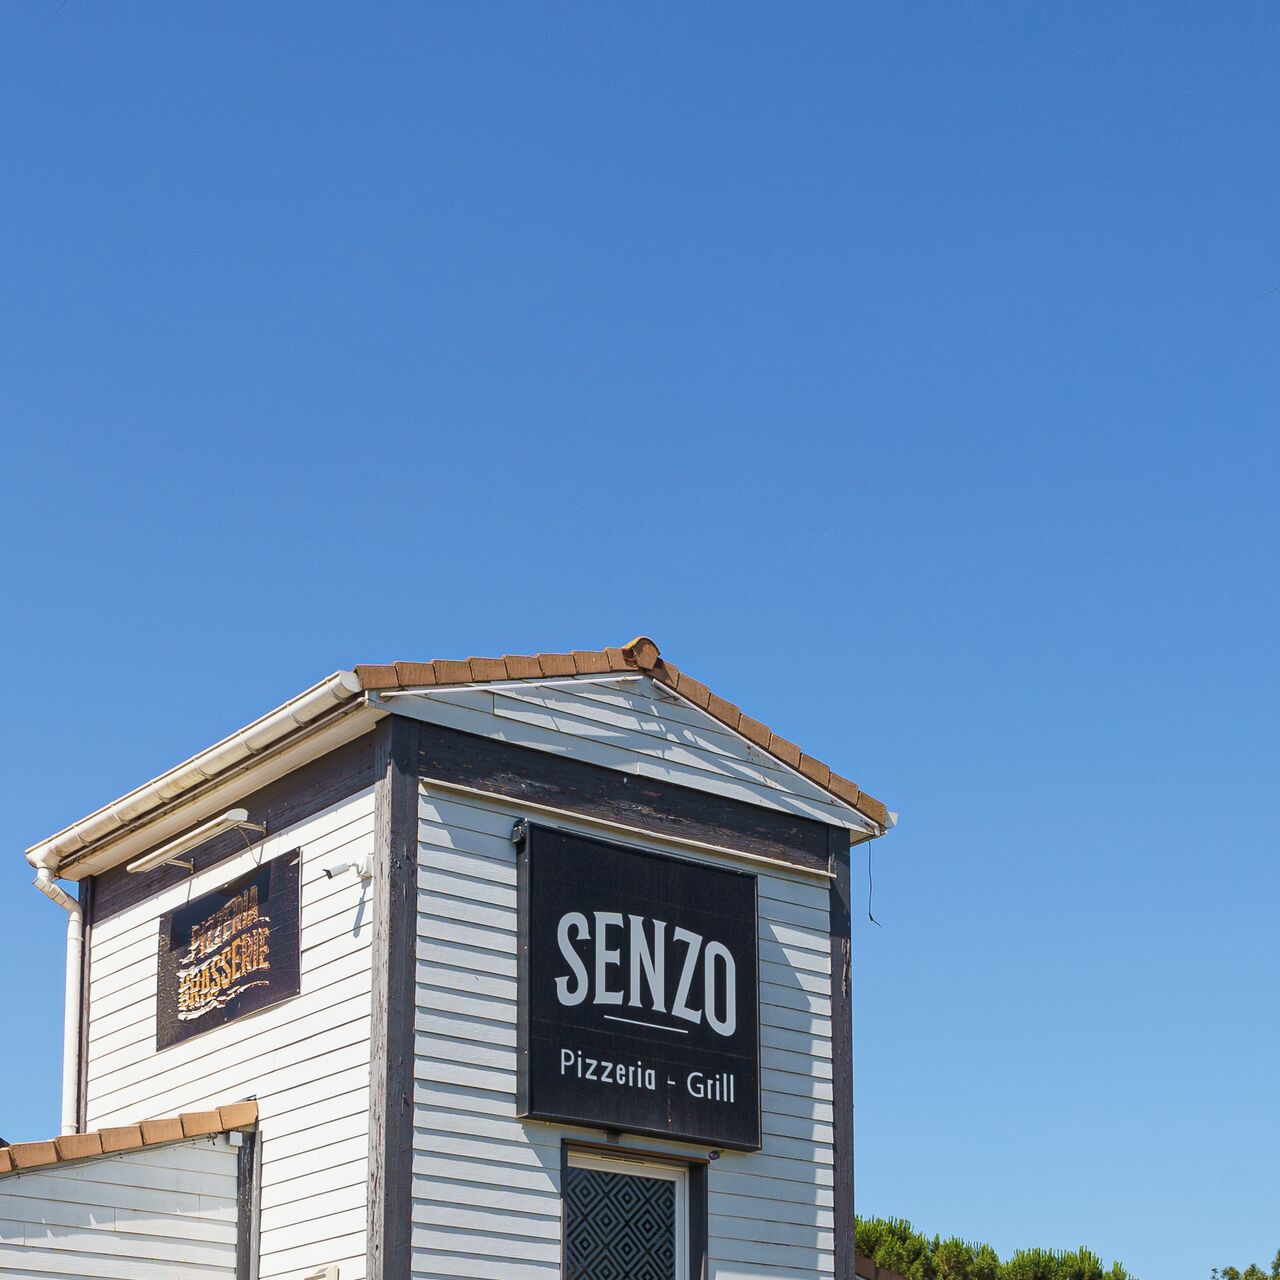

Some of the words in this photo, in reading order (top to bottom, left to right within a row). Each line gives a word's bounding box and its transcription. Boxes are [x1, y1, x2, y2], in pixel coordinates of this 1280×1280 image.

[554, 911, 737, 1037] SENZO
[560, 1048, 656, 1090] Pizzeria
[686, 1071, 735, 1103] Grill
